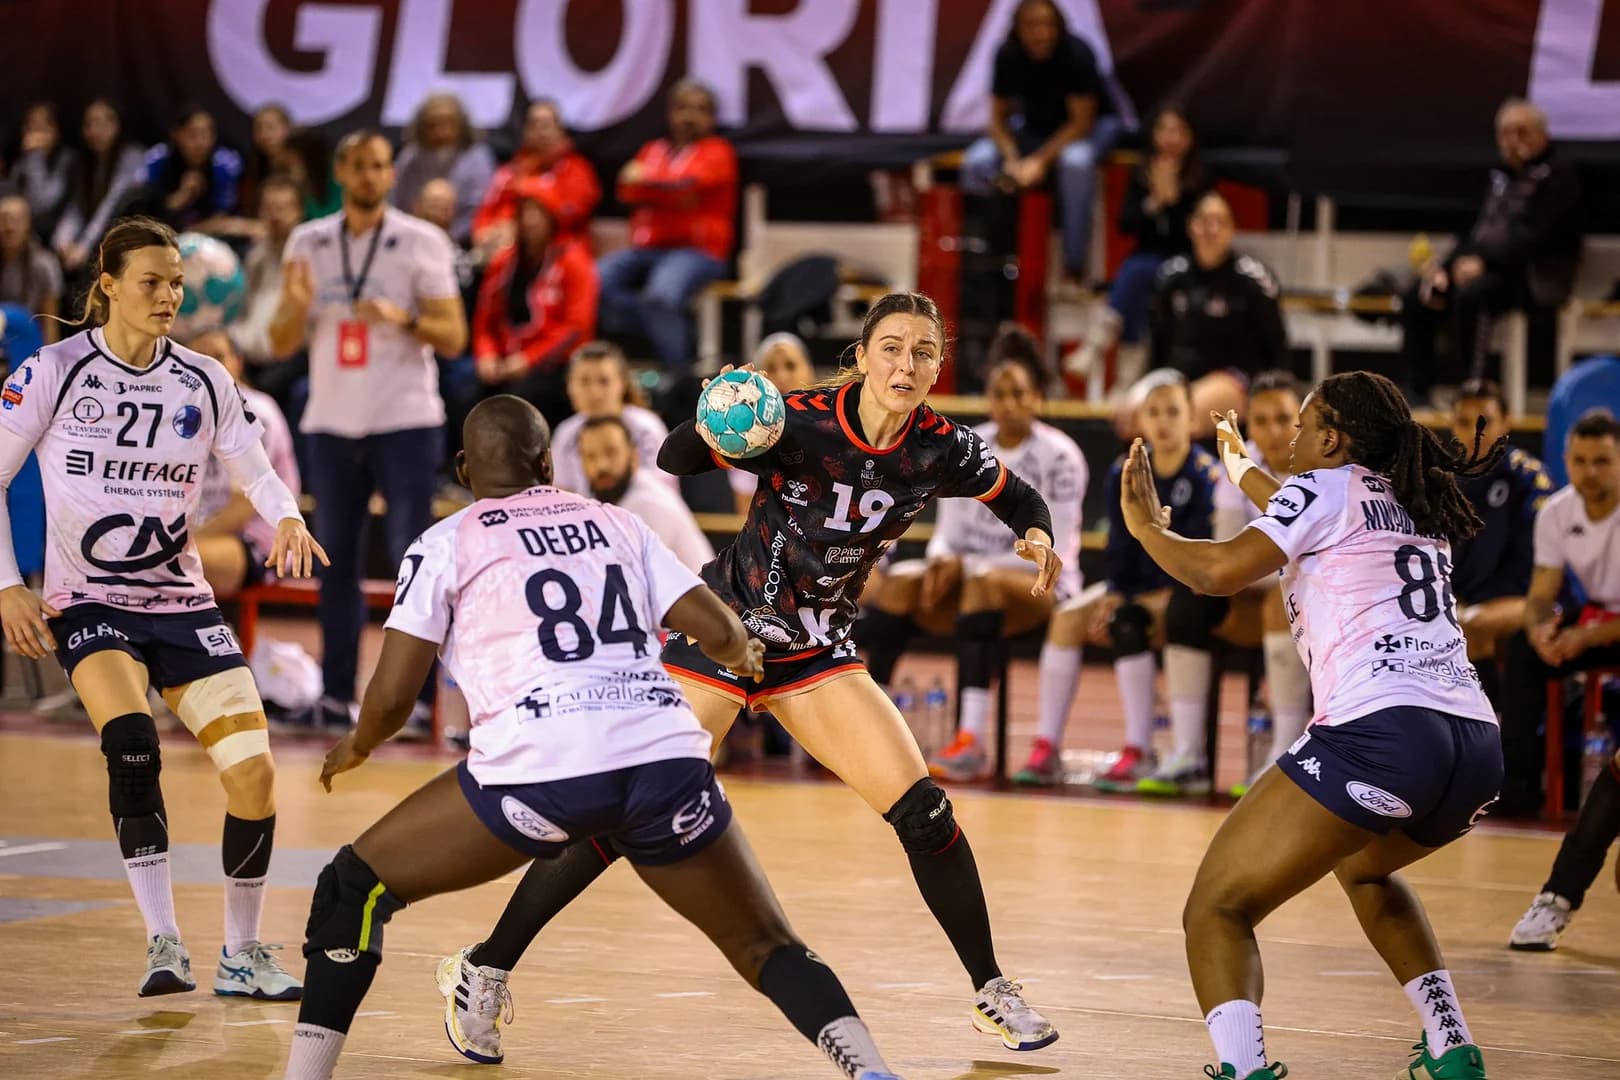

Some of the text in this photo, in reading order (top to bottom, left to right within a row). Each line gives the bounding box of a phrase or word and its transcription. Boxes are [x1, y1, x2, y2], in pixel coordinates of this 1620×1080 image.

[129, 383, 163, 393] PAPREC
[62, 423, 73, 431] LA
[73, 425, 113, 435] TAVERNE
[116, 401, 164, 448] 27
[103, 459, 199, 484] EIFFAGE
[823, 481, 896, 534] 19
[516, 519, 610, 557] DEBA
[841, 545, 865, 556] Pitch
[525, 563, 650, 663] 84
[122, 754, 150, 763] SELECT
[1360, 790, 1401, 812] Ford
